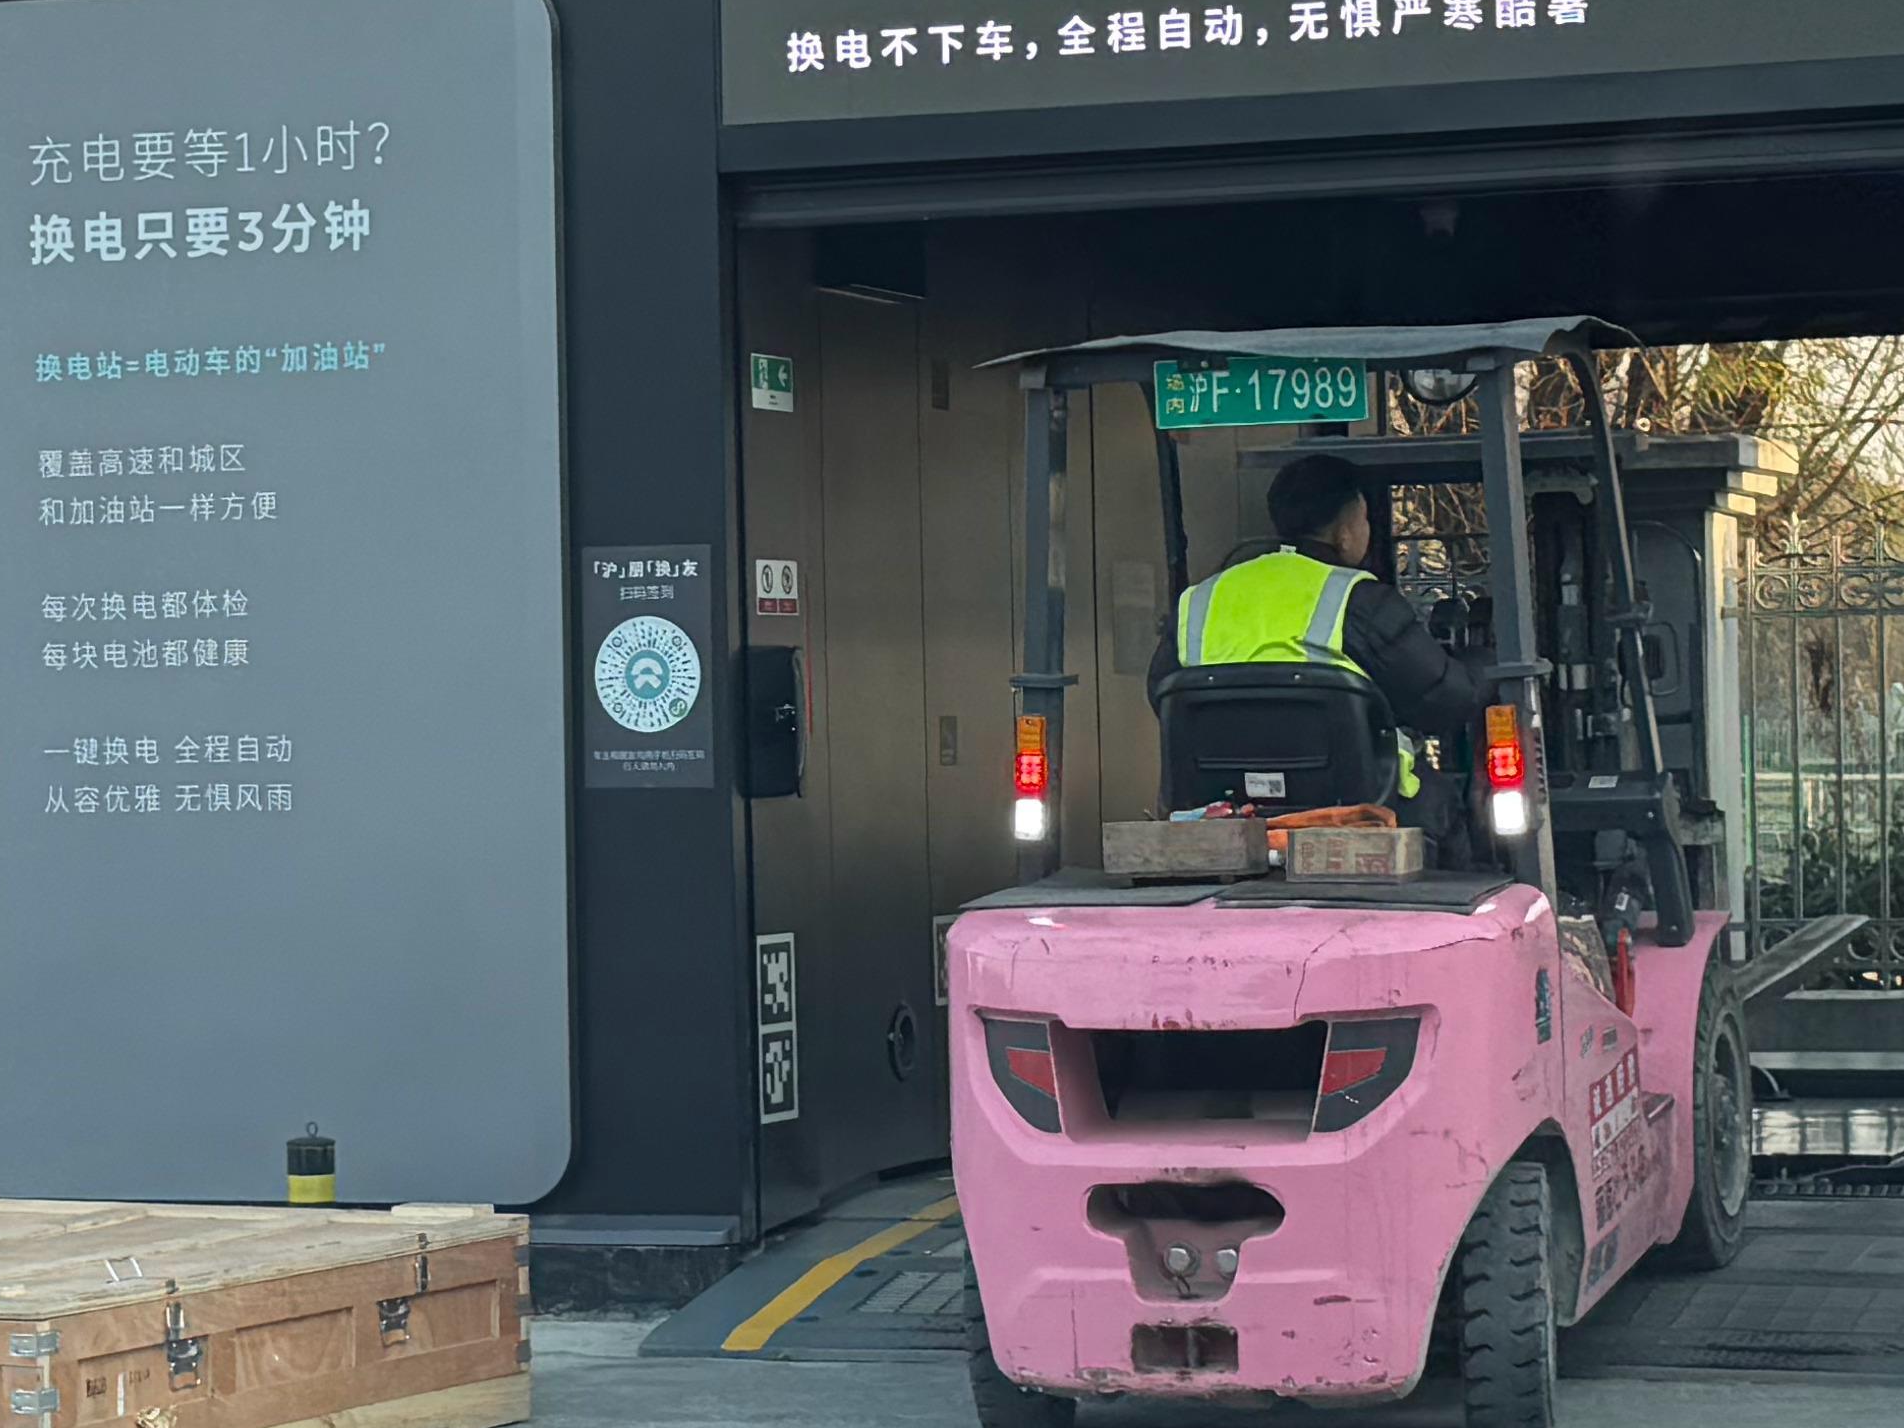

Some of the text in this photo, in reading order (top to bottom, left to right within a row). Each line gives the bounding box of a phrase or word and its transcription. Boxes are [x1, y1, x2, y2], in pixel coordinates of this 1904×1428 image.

[28, 120, 391, 186] 充电要等1小时？
[29, 198, 371, 266] 换电只要3分钟
[38, 443, 246, 479] 覆盖高速和城区
[38, 491, 278, 526] 和加油站一样方便
[40, 588, 249, 622] 每次换电都体检
[41, 638, 250, 671] 每块电池都健康
[42, 734, 293, 766] 一键换电 全程自动
[44, 783, 293, 814] 从容优雅 无惧风雨
